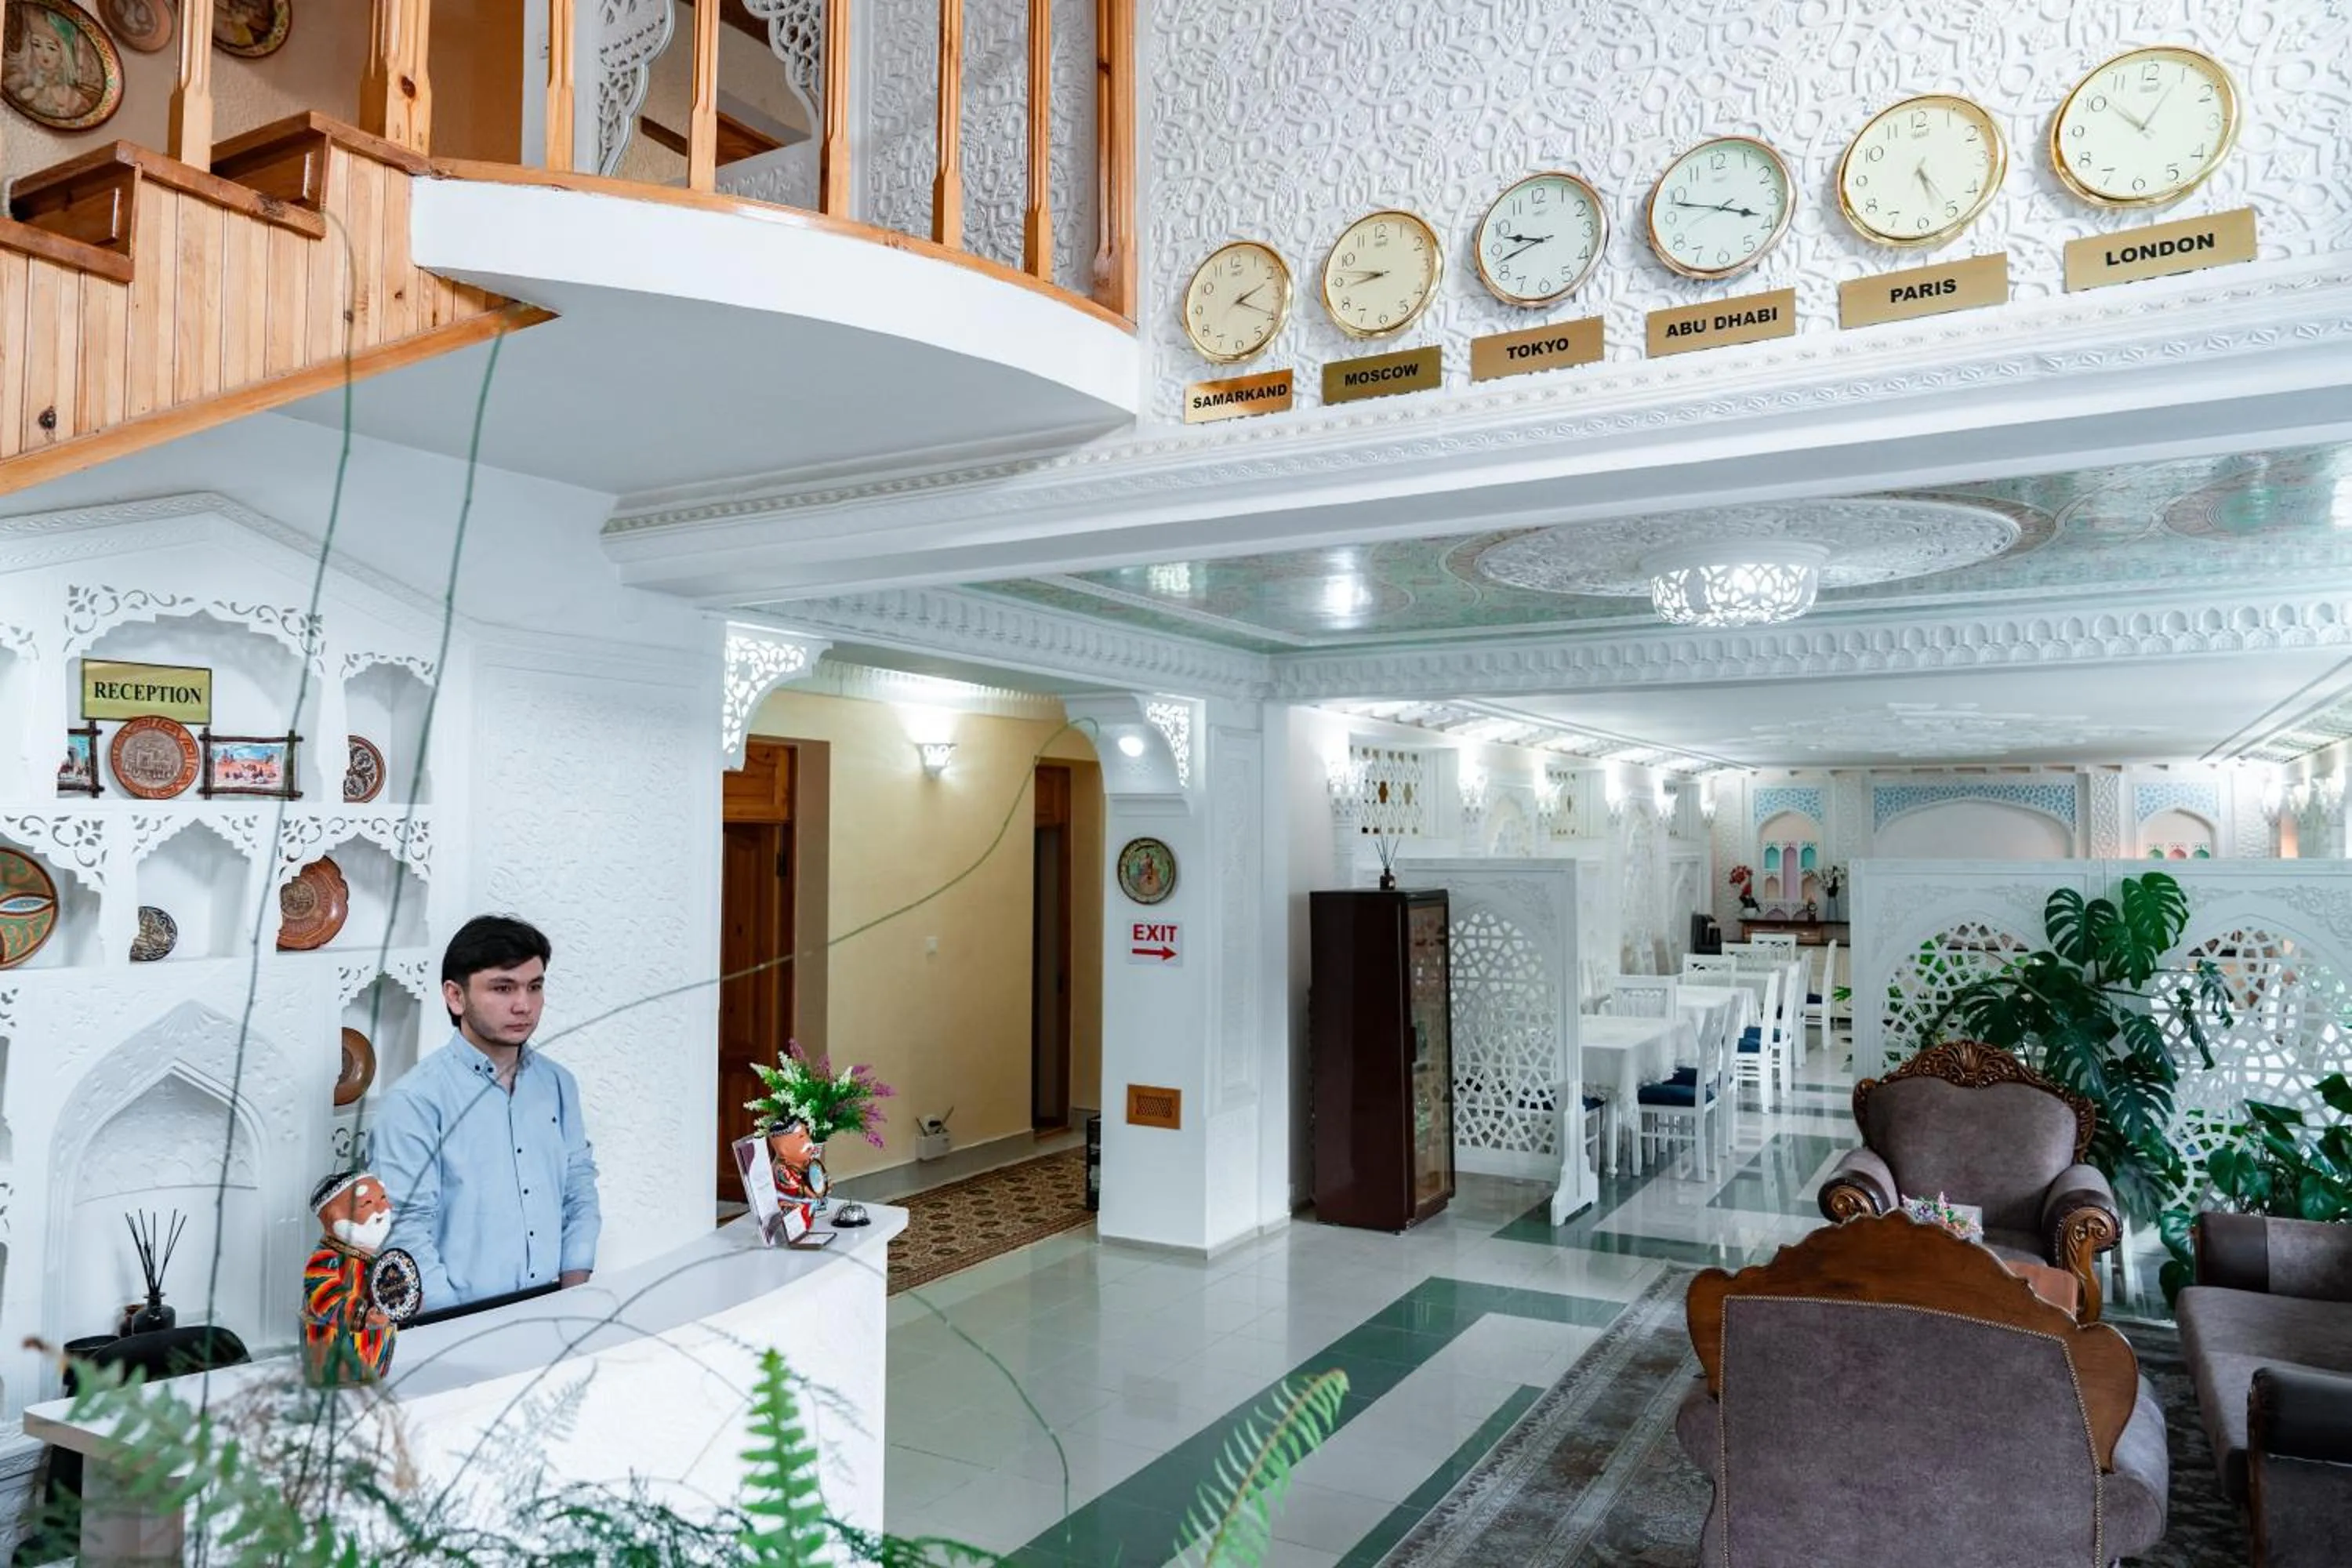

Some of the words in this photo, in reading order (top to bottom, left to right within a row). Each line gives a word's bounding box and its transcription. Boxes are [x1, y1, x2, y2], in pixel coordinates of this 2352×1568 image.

[2142, 64, 2159, 81] 12
[2114, 74, 2125, 91] 11
[2198, 84, 2213, 103] 2
[2085, 96, 2107, 113] 10
[1911, 111, 1928, 129] 12
[1887, 124, 1898, 140] 11
[1965, 125, 1977, 142] 2
[1865, 145, 1884, 163] 10
[1976, 151, 1988, 166] 3
[2078, 151, 2092, 168] 8
[2190, 143, 2204, 159] 4
[1710, 153, 1725, 170] 12
[1690, 166, 1699, 183] 11
[1758, 165, 1771, 184] 2
[2102, 168, 2115, 186] 7
[2166, 163, 2179, 181] 5
[1531, 187, 1545, 204] 12
[1766, 188, 1779, 205] 3
[1512, 200, 1522, 216] 11
[1574, 200, 1586, 216] 2
[1866, 198, 1878, 214] 8
[1945, 201, 1958, 218] 5
[1496, 219, 1511, 236] 10
[1760, 215, 1773, 230] 4
[1887, 211, 1900, 227] 7
[1581, 221, 1593, 238] 3
[1673, 234, 1685, 251] 8
[1743, 235, 1755, 253] 5
[2105, 232, 2216, 267] LONDON
[1577, 245, 1589, 260] 4
[1692, 245, 1704, 263] 7
[1717, 248, 1730, 264] 6
[1498, 264, 1510, 281] 8
[1562, 266, 1573, 282] 5
[1516, 276, 1526, 292] 7
[1539, 278, 1551, 293] 6
[1889, 278, 1957, 303] PARIS
[1665, 319, 1706, 338] ABU
[1714, 307, 1778, 330] DHABI
[1506, 337, 1569, 360] TOKYO
[1345, 364, 1419, 387] MOSCOW
[1193, 383, 1287, 408] SAMARKAND
[94, 681, 201, 704] RECEPTION
[1133, 924, 1178, 942] EXIT
